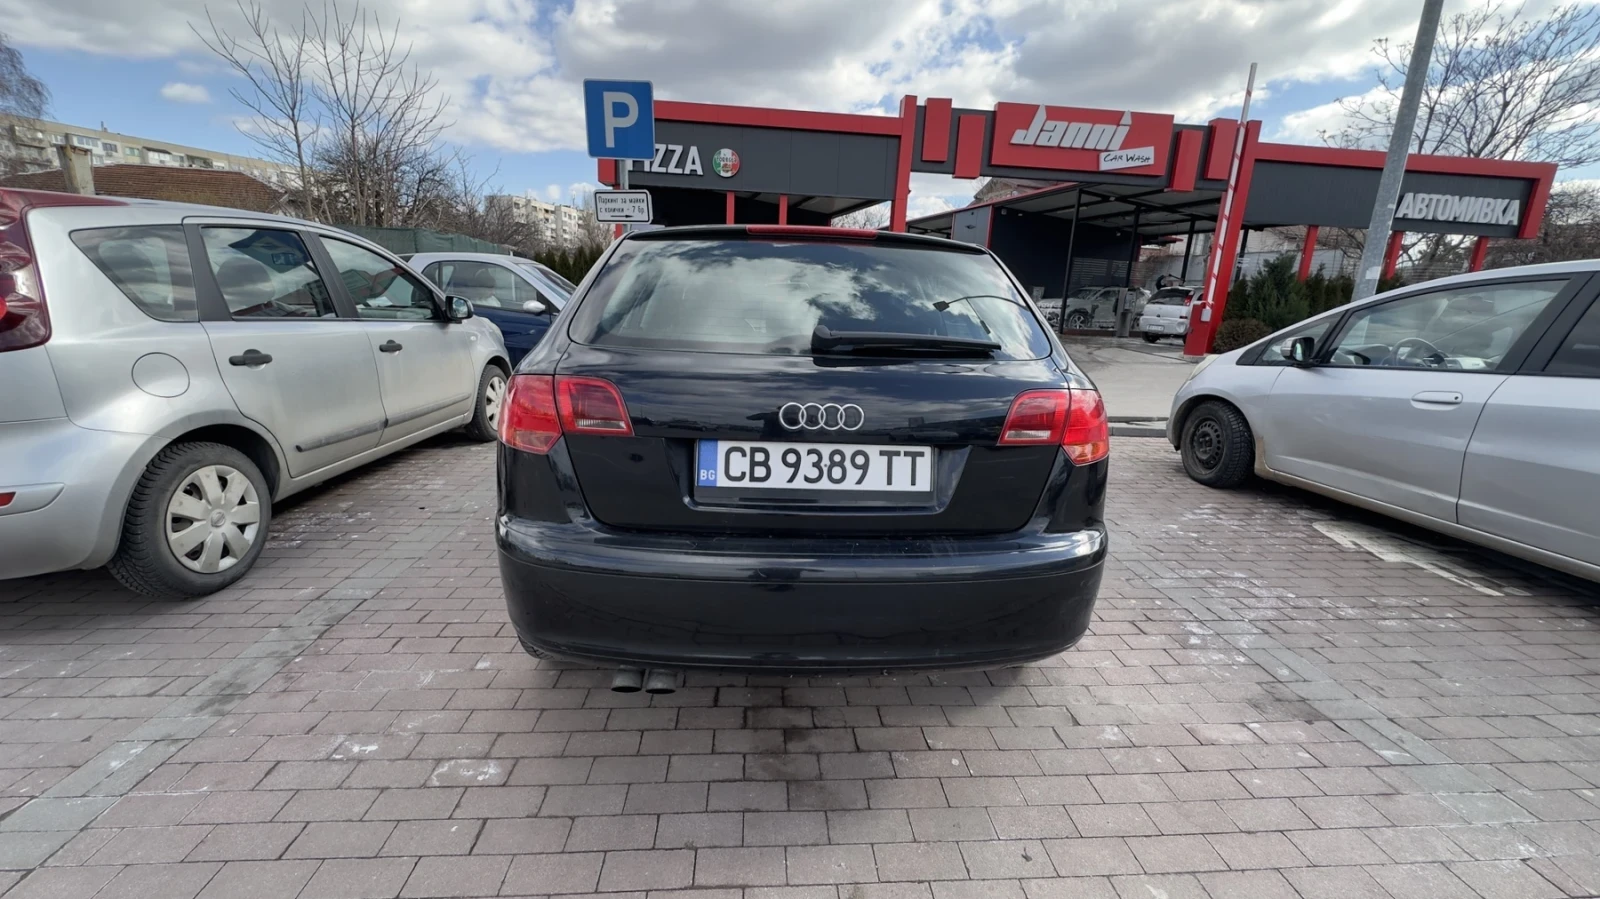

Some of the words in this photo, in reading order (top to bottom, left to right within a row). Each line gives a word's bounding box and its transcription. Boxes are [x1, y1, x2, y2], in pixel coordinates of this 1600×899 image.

[603, 91, 639, 148] P
[1010, 103, 1132, 151] Janni
[1103, 153, 1123, 162] CAR
[1126, 153, 1151, 163] WASH
[598, 196, 618, 205] Паркинг
[1395, 192, 1520, 225] АВТОМИВКА
[700, 469, 716, 481] BG
[724, 446, 772, 483] CB
[781, 448, 870, 485] 9389
[879, 450, 925, 486] TT
